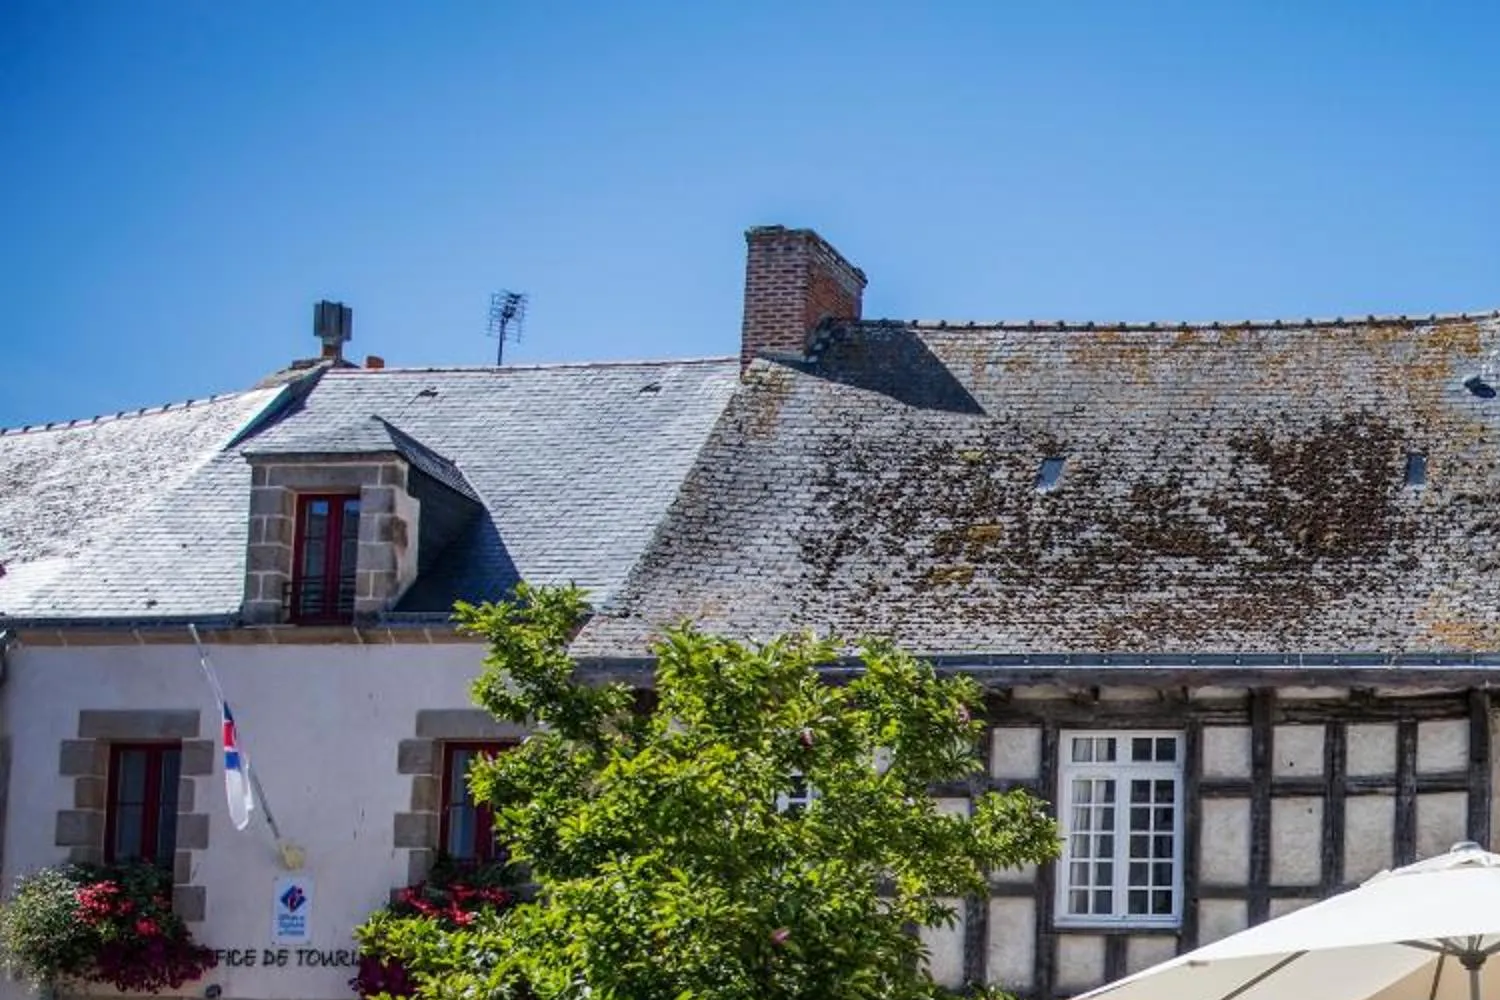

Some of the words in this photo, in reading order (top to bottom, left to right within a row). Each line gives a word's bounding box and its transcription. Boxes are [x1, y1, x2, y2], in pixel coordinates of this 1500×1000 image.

[215, 948, 257, 968] FICE
[262, 948, 289, 968] DE
[295, 948, 356, 968] TOURI
